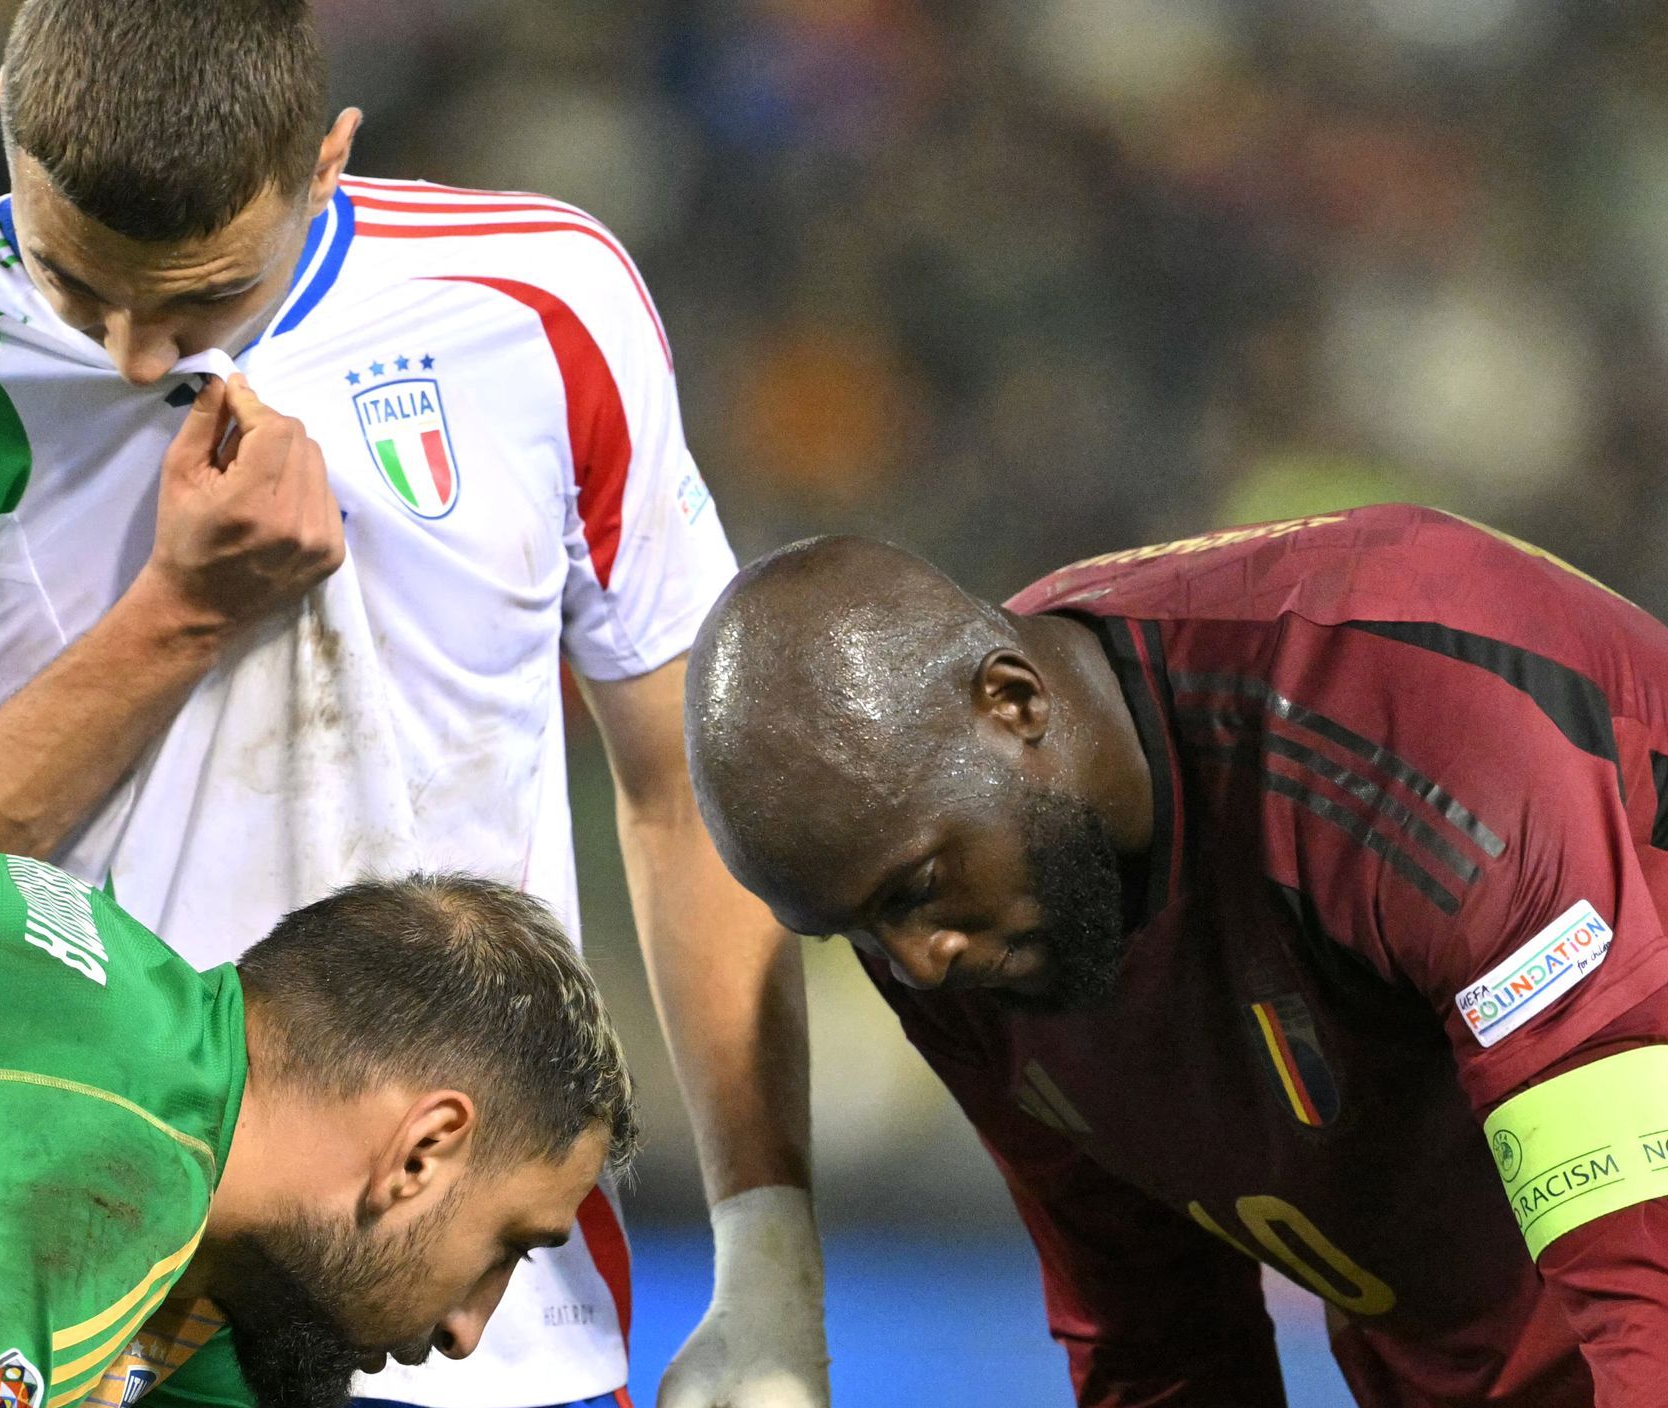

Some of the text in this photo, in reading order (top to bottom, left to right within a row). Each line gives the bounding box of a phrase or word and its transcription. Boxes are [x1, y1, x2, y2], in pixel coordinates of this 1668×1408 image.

[363, 390, 435, 425] ITALIA
[1577, 959, 1588, 974] for
[1459, 984, 1490, 1010] UEFA
[1519, 1154, 1619, 1218] RACISM
